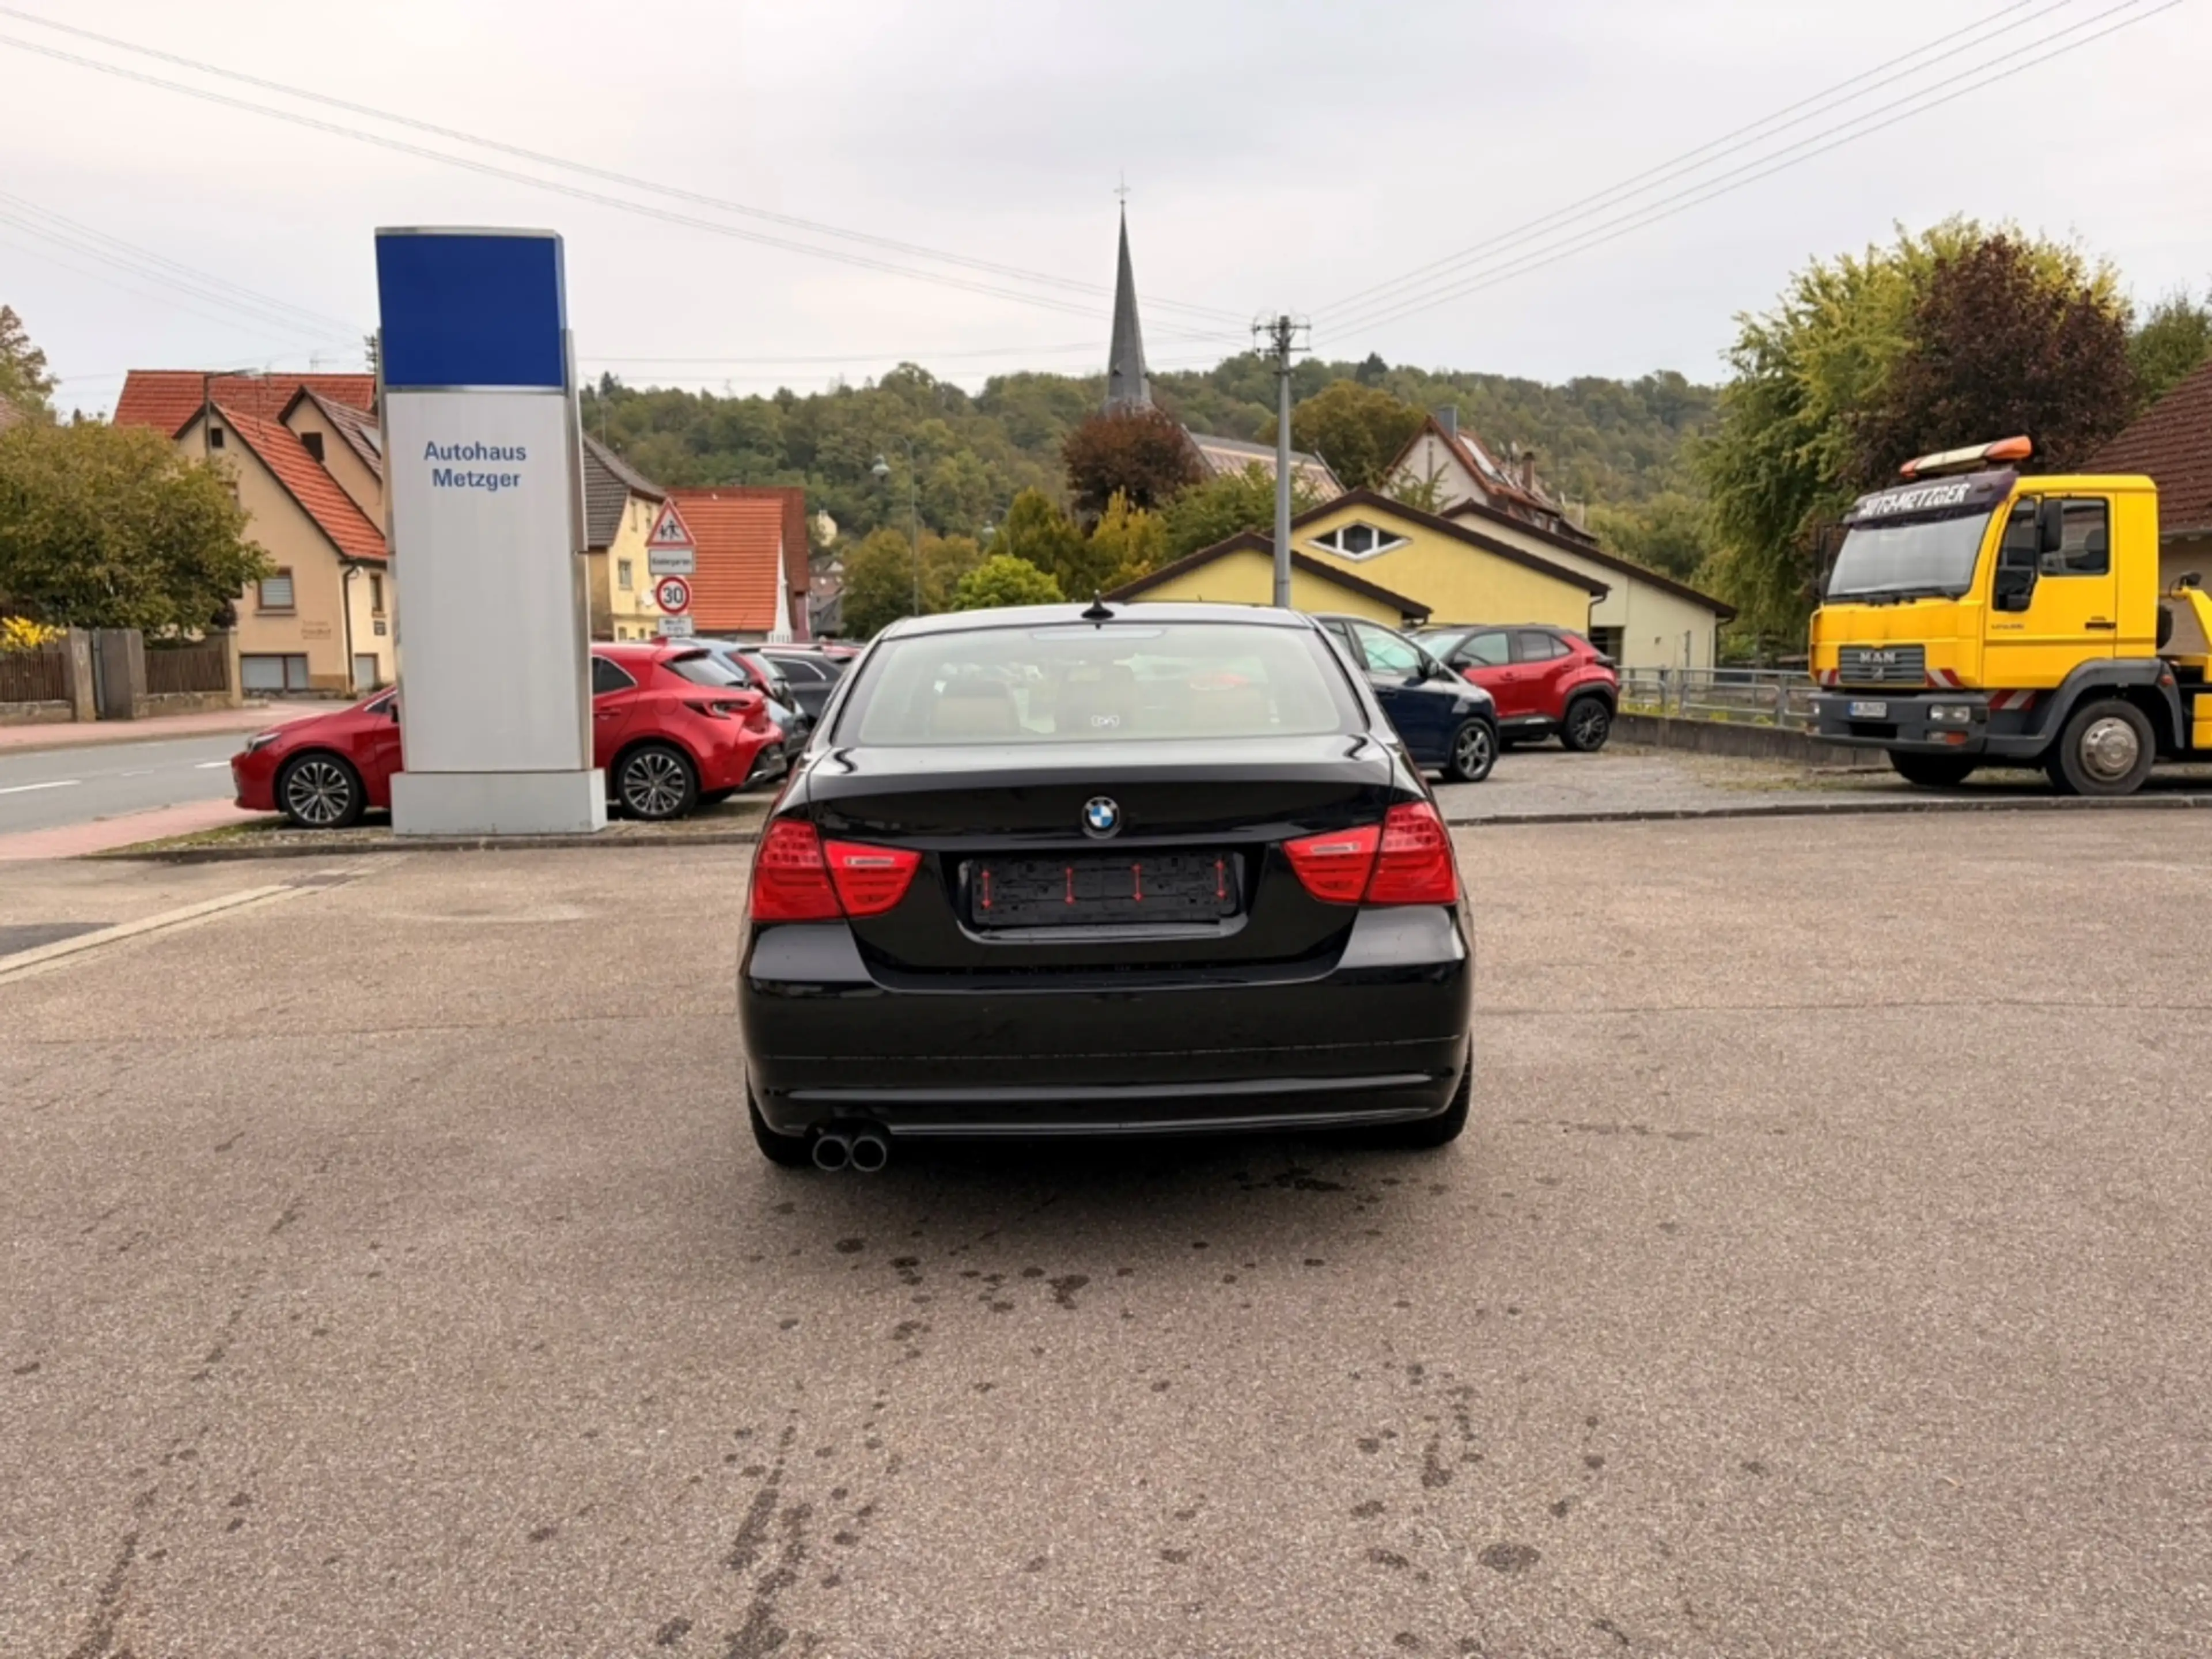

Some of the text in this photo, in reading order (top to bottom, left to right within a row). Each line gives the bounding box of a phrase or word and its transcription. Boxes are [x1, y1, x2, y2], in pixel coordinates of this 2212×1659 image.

[423, 441, 527, 461] Autohaus
[433, 468, 521, 491] Metzger
[664, 586, 683, 604] 30
[1859, 652, 1896, 664] MAN
